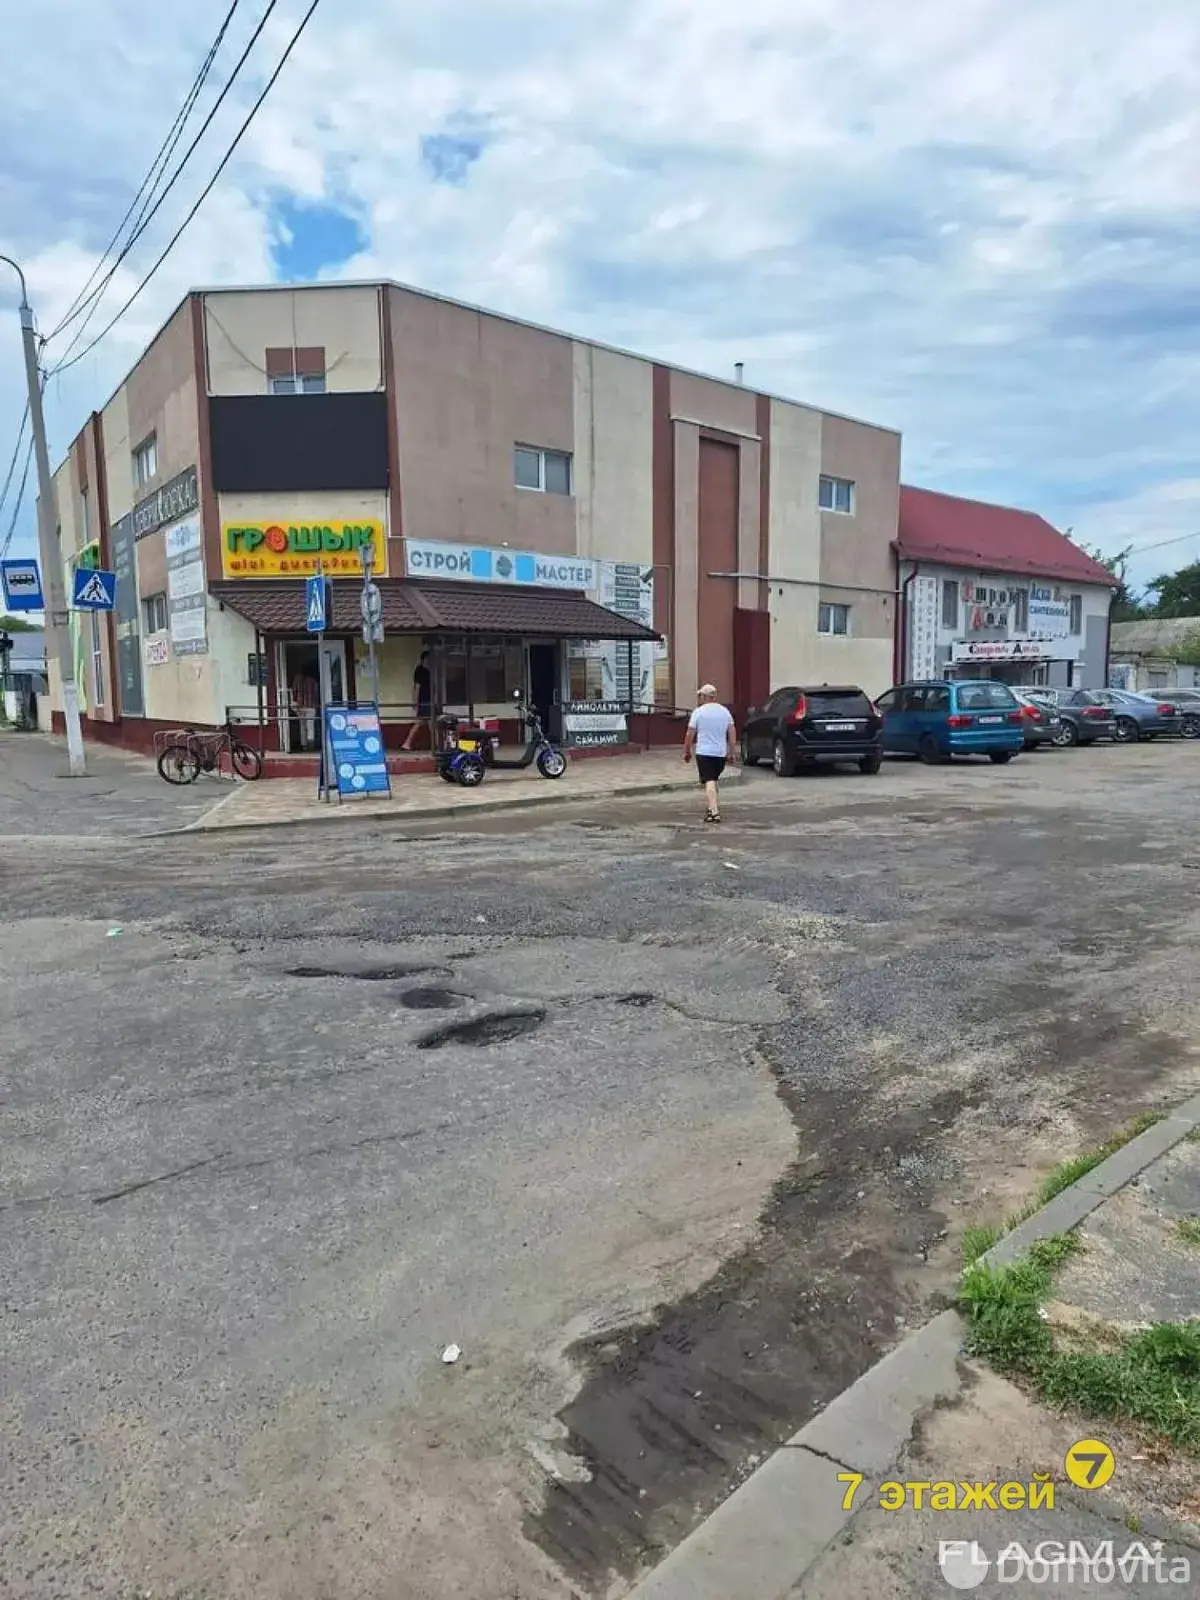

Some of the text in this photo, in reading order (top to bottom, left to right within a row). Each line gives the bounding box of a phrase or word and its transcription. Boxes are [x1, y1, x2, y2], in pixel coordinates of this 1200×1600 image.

[227, 526, 373, 554] ГРОШЫК
[410, 550, 471, 574] СТРОЙ
[535, 563, 593, 583] МАСТЕР
